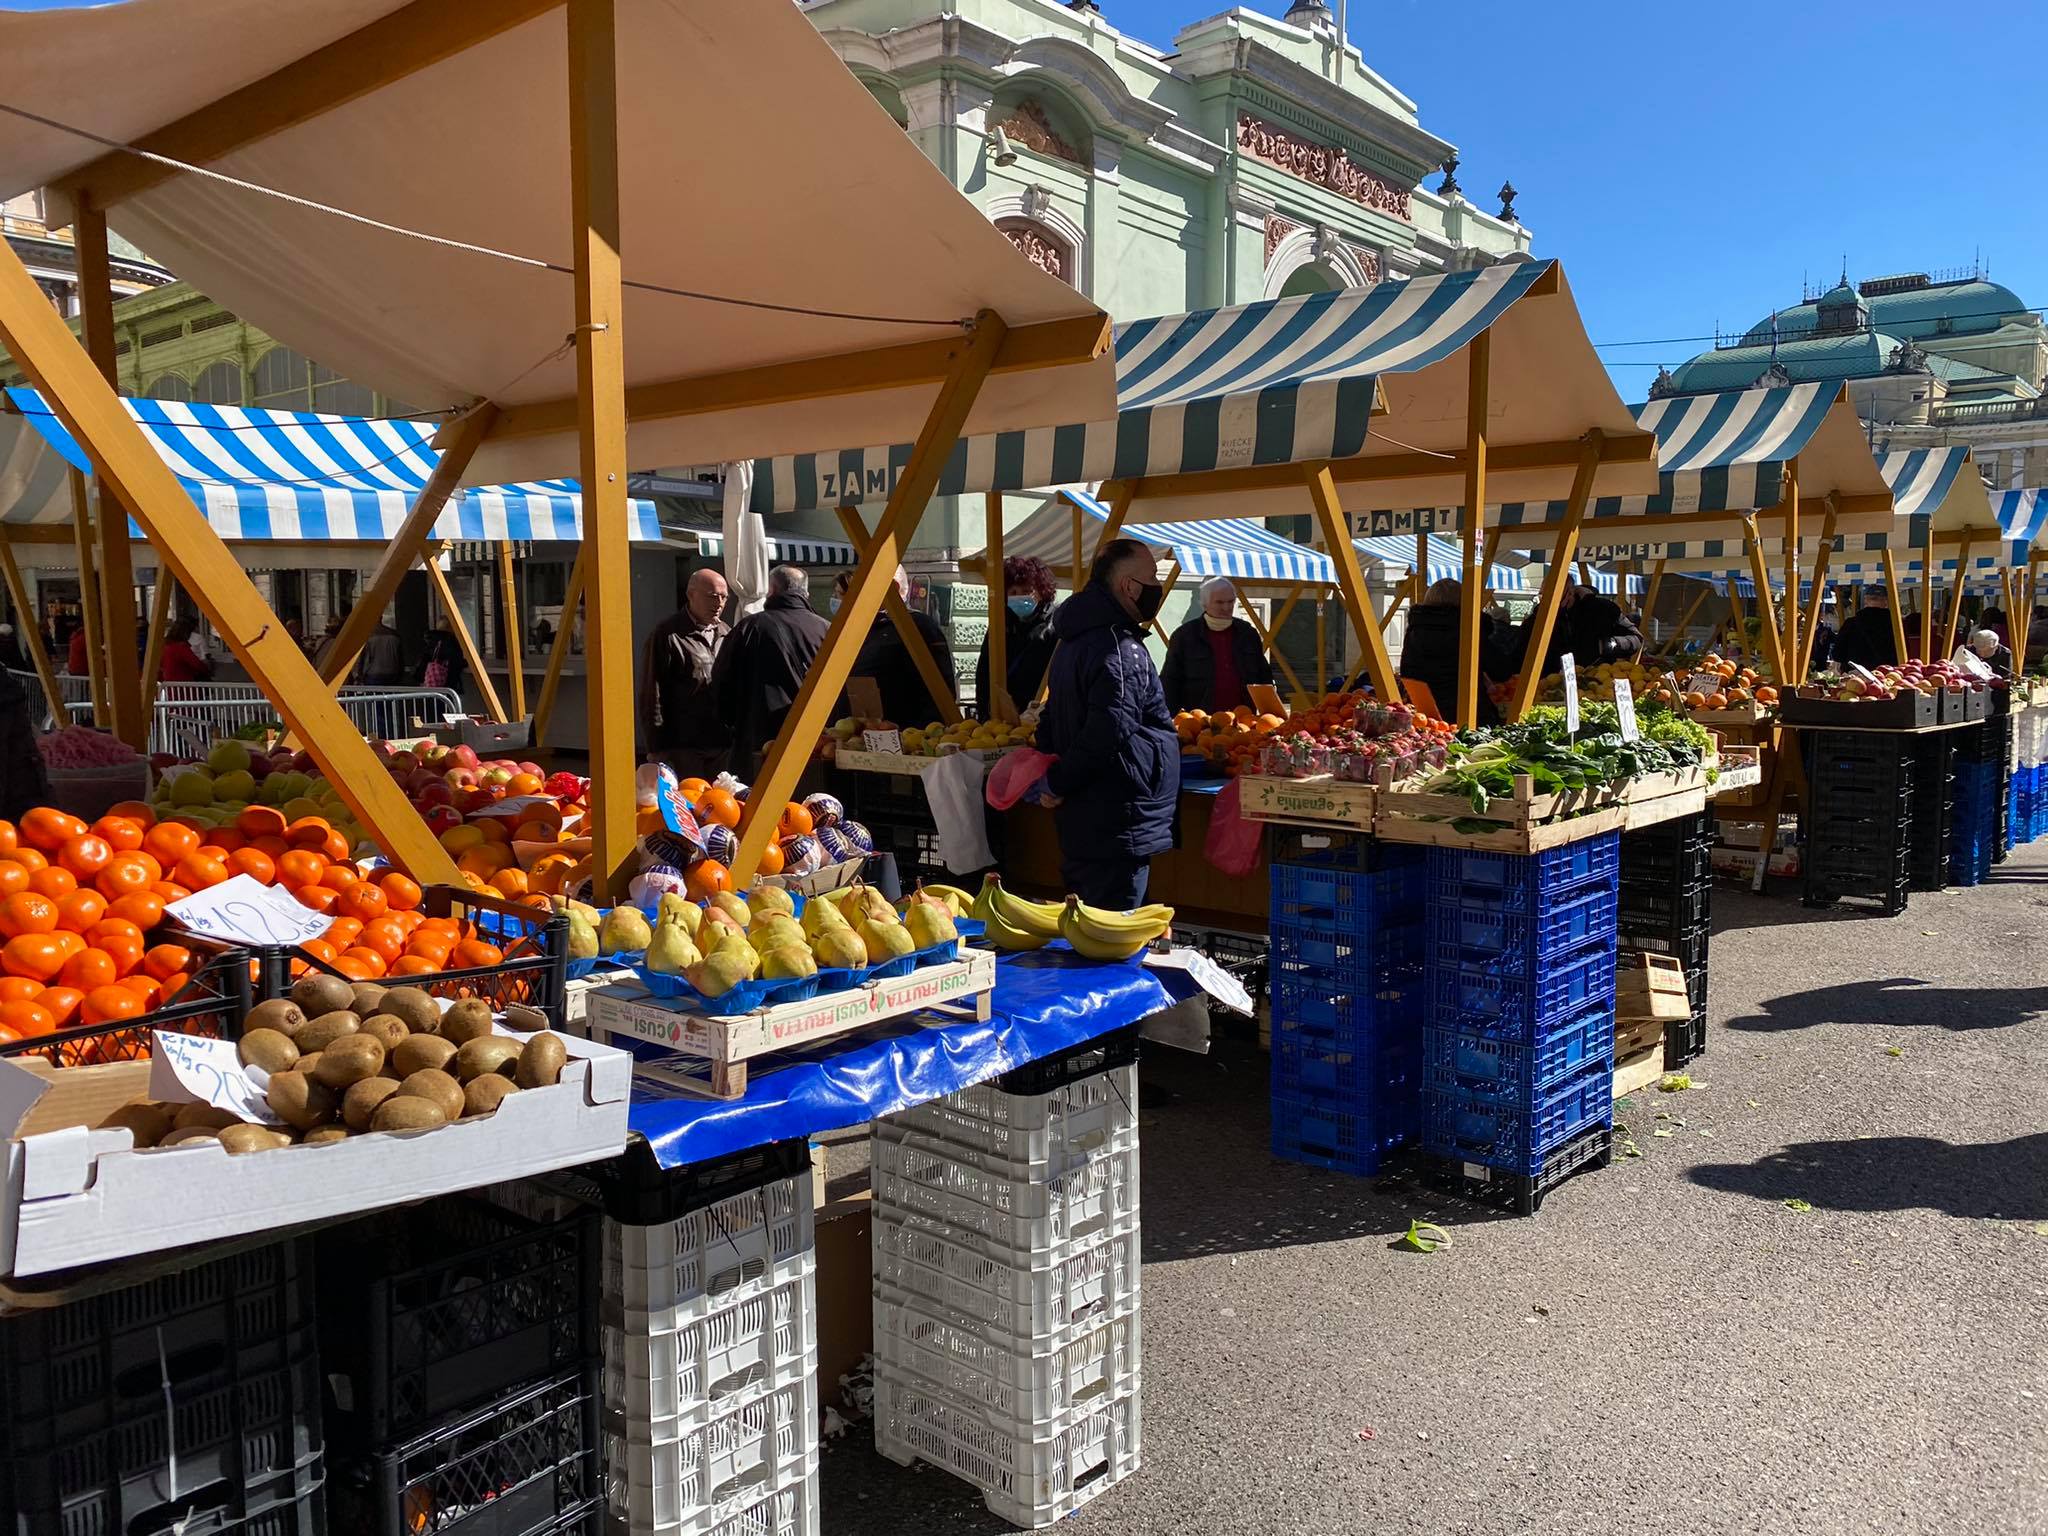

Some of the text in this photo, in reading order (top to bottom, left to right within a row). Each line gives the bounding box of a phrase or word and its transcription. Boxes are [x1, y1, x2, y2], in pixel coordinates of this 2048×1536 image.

[1357, 508, 1450, 533] ZAMET
[1583, 542, 1663, 558] ZAMET
[1276, 795, 1336, 811] egnathia
[940, 973, 968, 992] CUSI
[885, 981, 939, 1009] FRUTTA
[836, 1001, 869, 1022] CUSI
[634, 1018, 666, 1039] CUSI
[161, 1033, 214, 1052] KIWI
